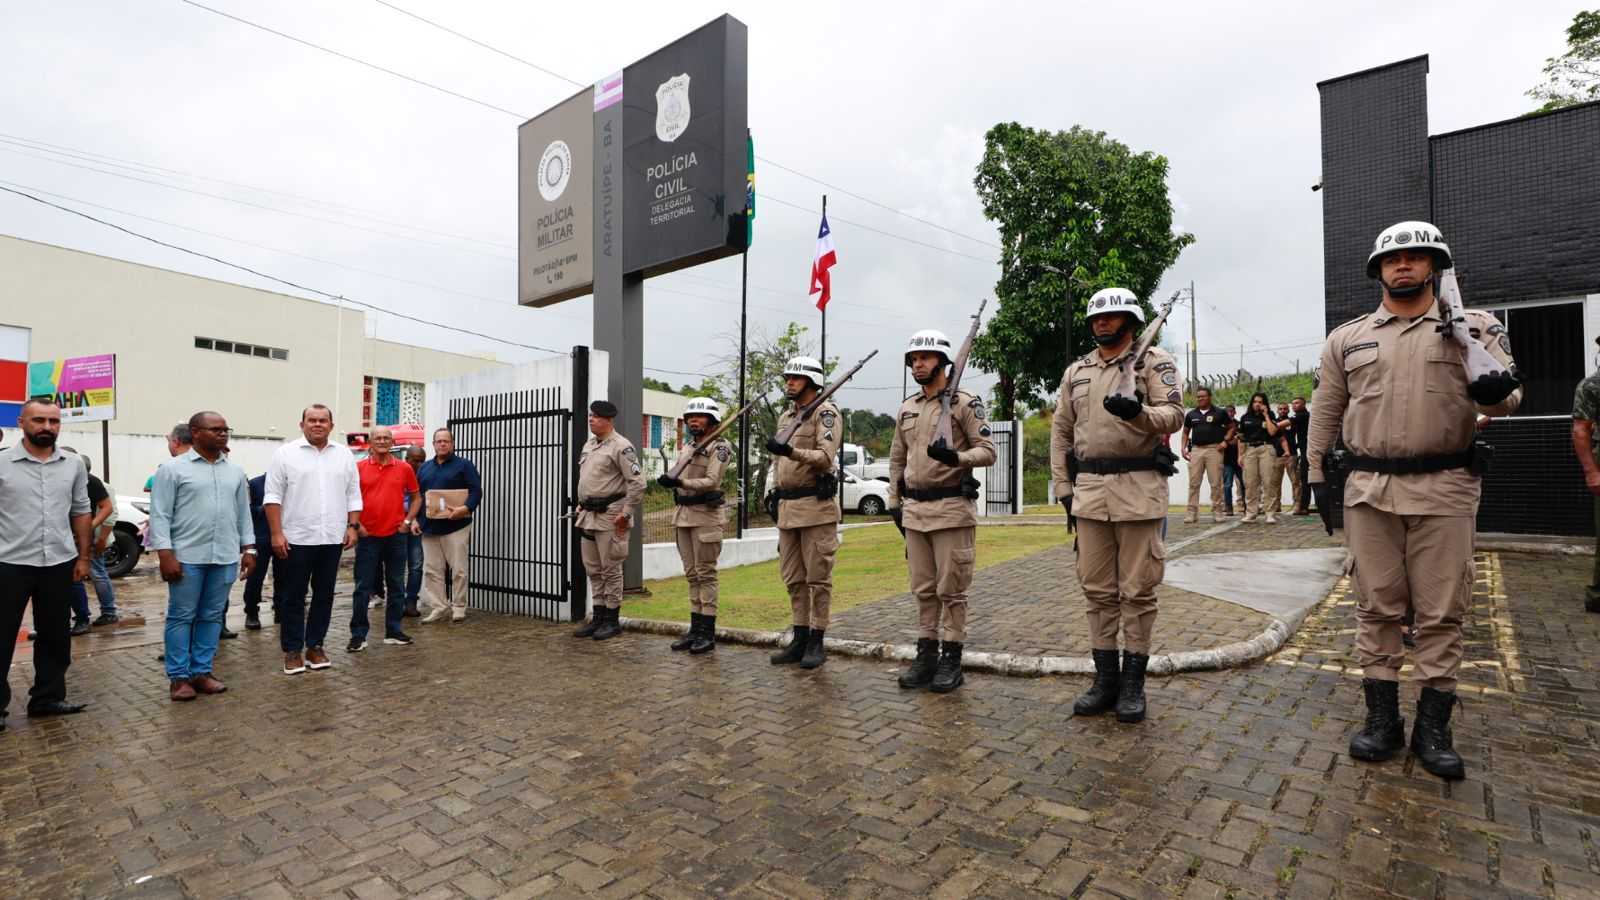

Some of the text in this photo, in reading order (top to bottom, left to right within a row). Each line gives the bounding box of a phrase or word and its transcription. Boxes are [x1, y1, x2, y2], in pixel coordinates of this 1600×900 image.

[603, 119, 613, 147] BA
[647, 151, 698, 182] POLÍCIA
[655, 177, 688, 199] CIVIL
[650, 204, 696, 225] TERRITORIAL
[651, 194, 692, 215] DELEGACIA
[537, 204, 574, 231] POLÍCIA
[537, 223, 574, 248] MILITAR
